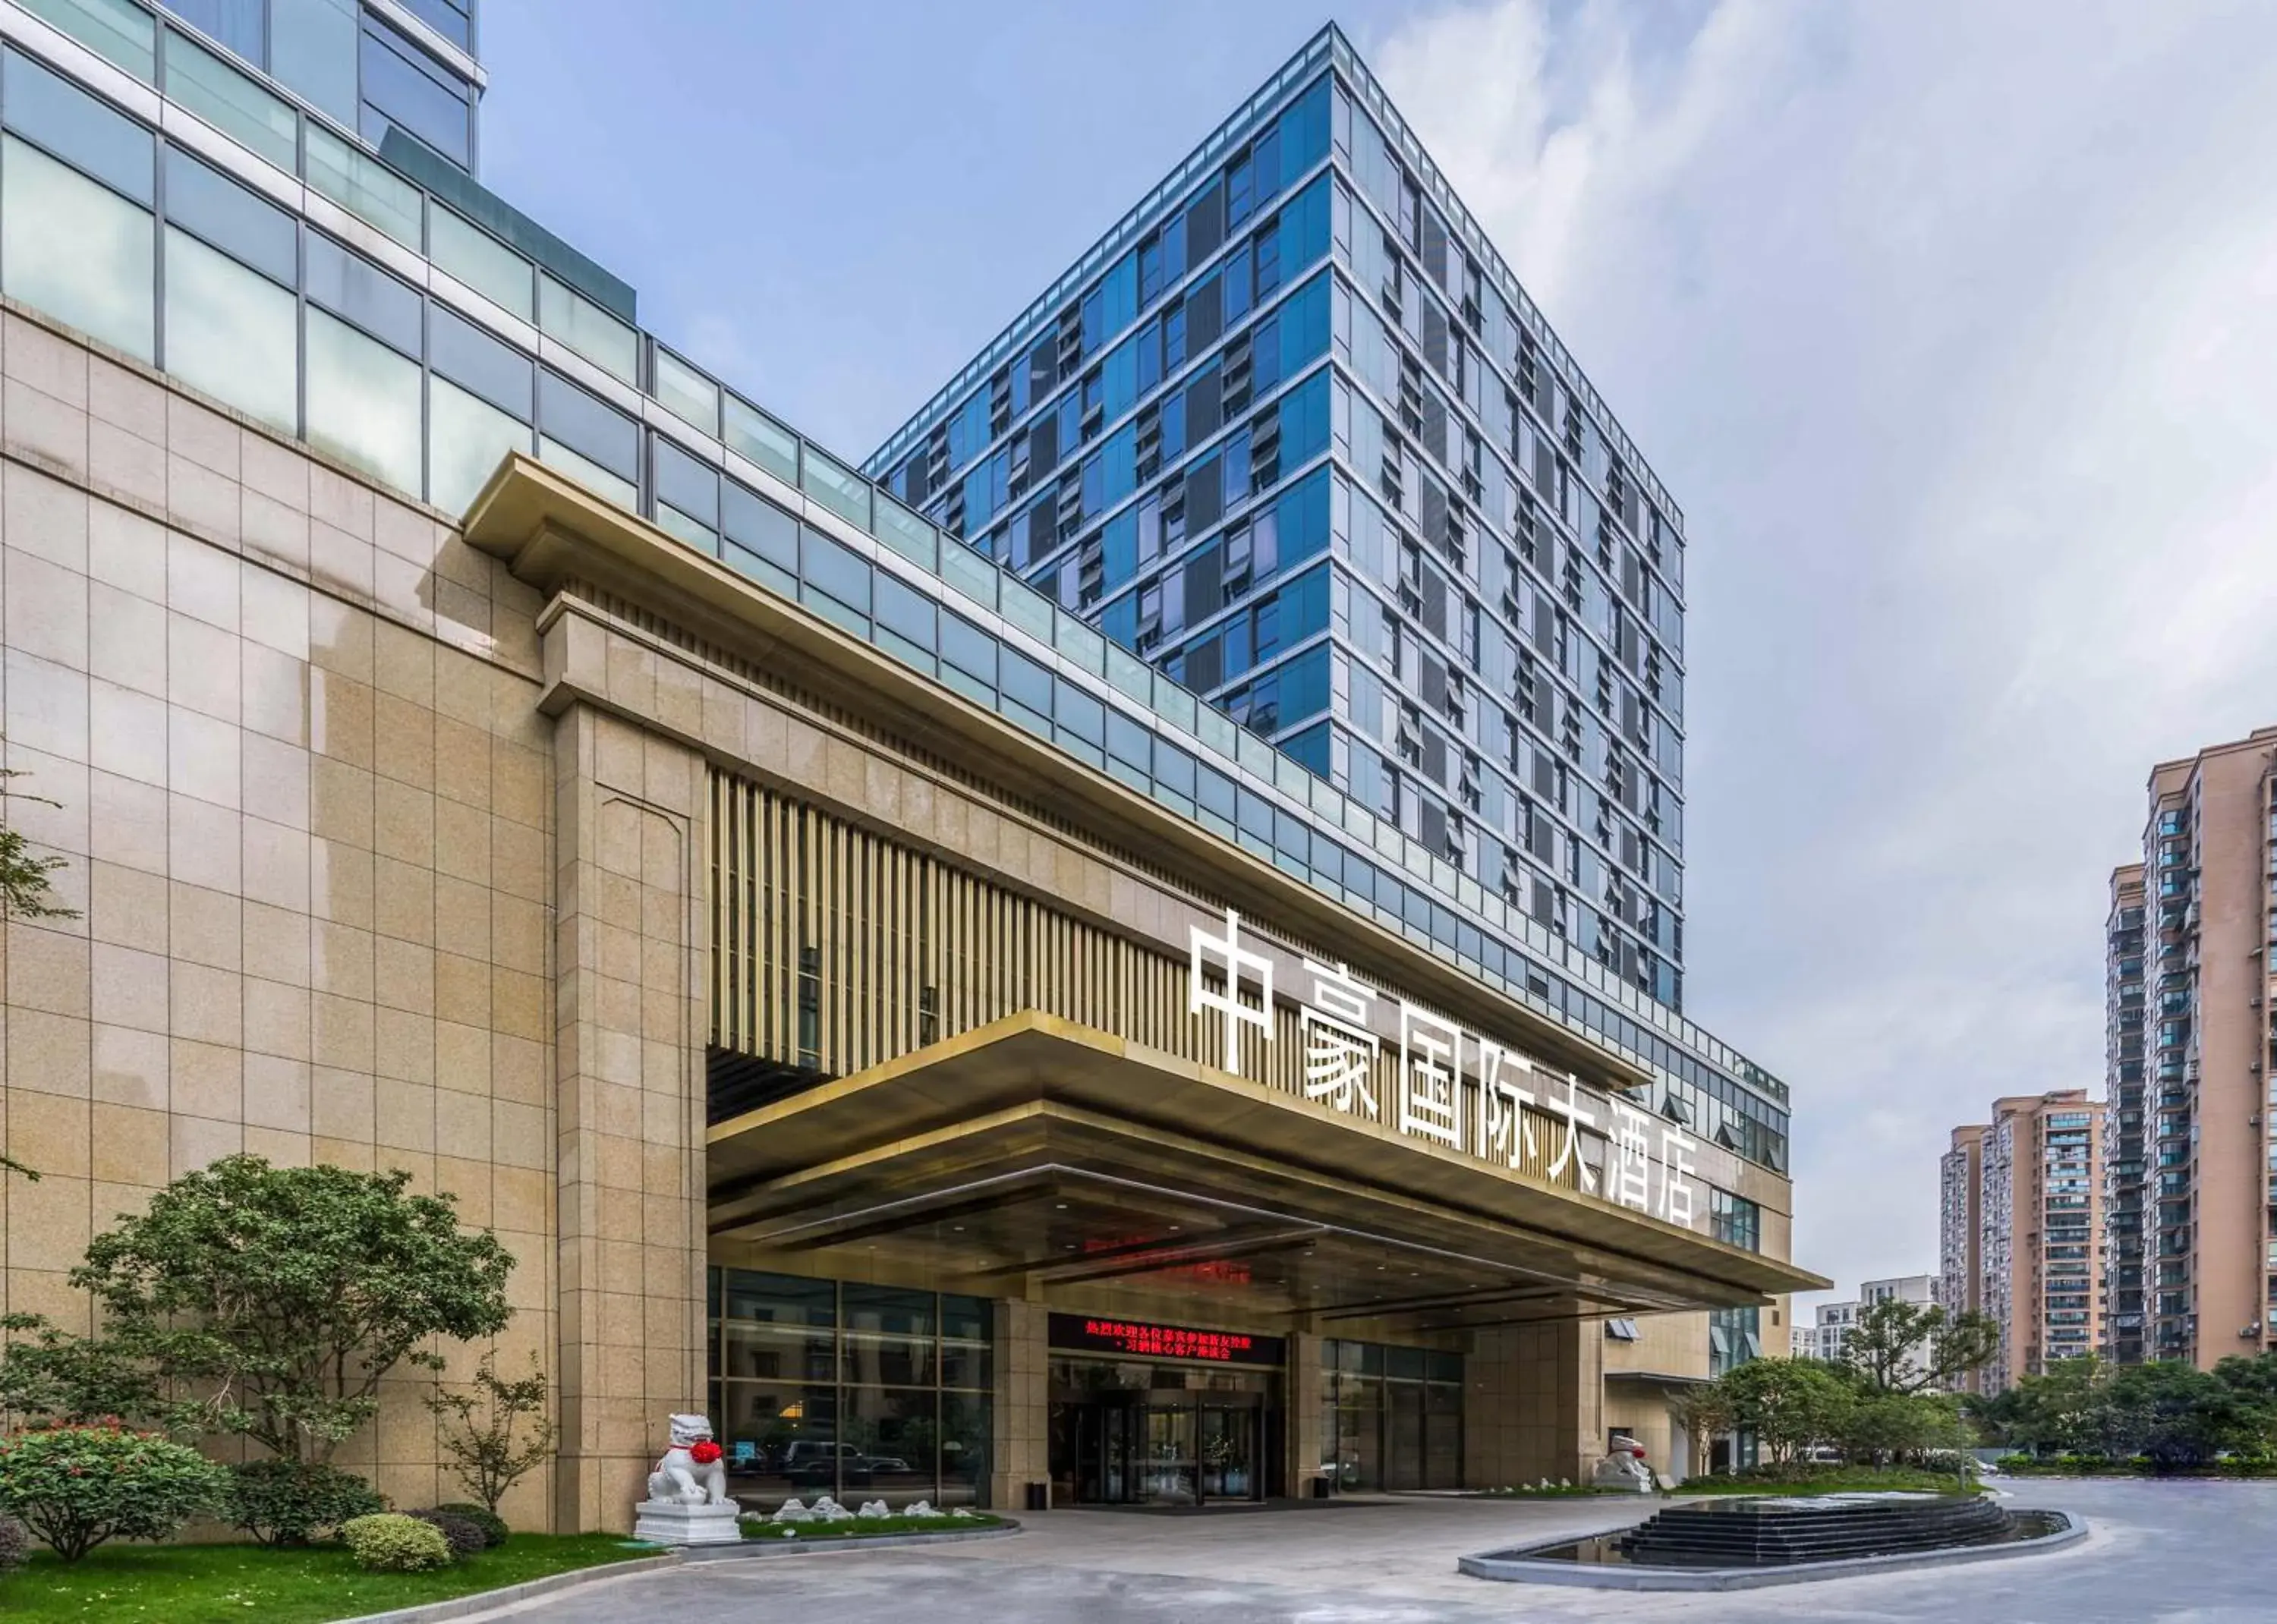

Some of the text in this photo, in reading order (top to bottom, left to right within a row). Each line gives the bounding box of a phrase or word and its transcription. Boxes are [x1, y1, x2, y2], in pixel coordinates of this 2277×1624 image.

[1189, 908, 1696, 1229] 中豪国际大酒店
